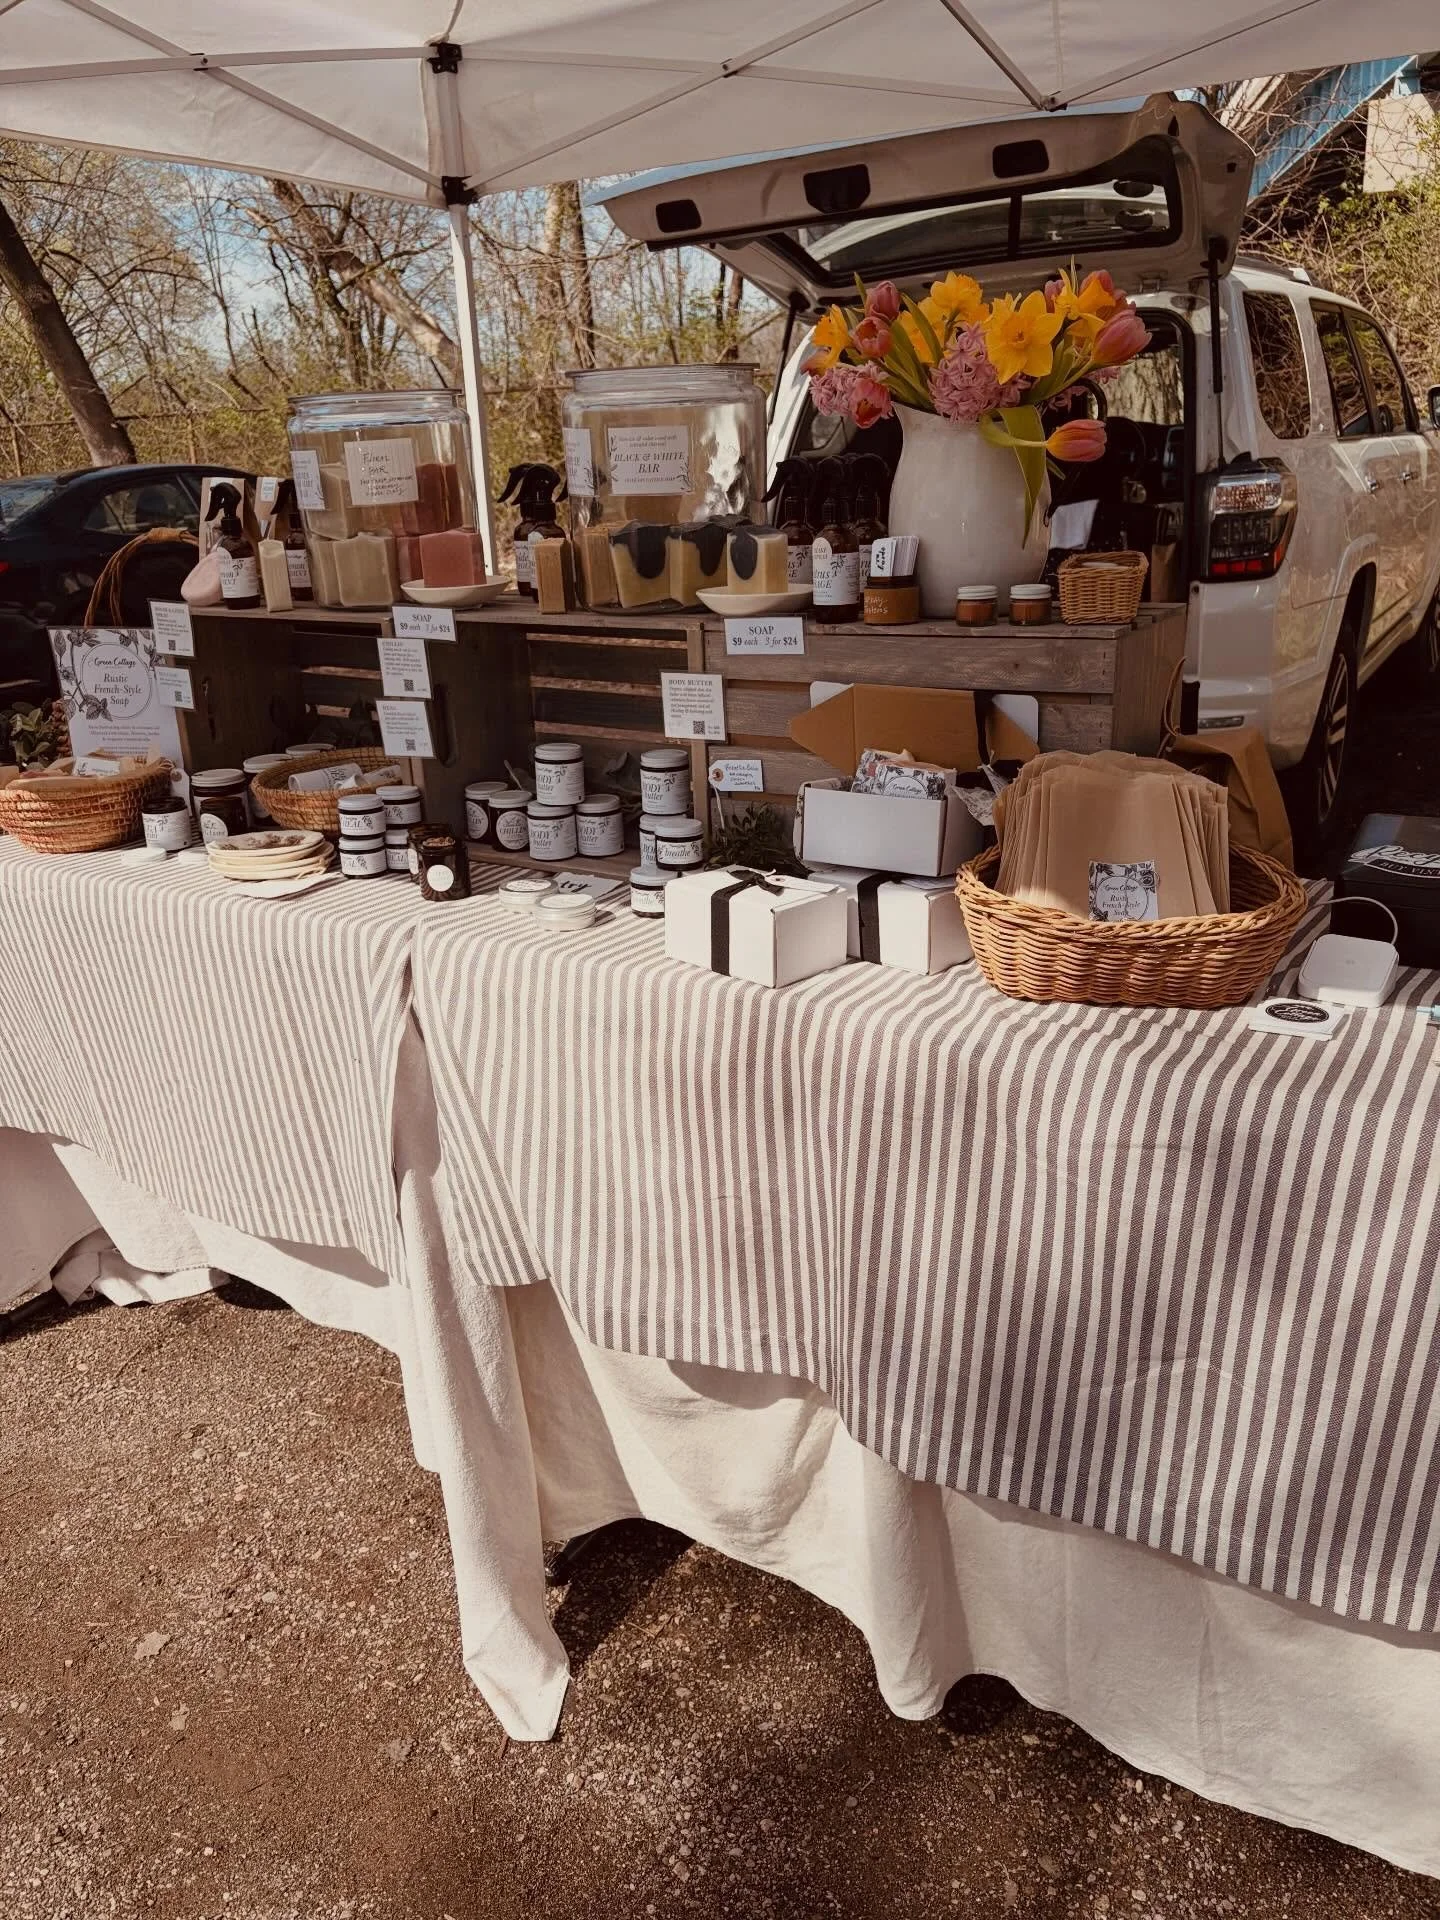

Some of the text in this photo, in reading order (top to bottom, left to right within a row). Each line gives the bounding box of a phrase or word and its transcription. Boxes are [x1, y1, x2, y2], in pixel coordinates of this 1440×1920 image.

[614, 451, 685, 462] BLACK & WHITE
[638, 463, 660, 473] BAR
[411, 614, 432, 623] SOAP
[399, 622, 408, 630] $9
[439, 624, 451, 633] $24
[748, 625, 775, 635] SOAP
[732, 636, 798, 648] $9 each 3 for $24
[94, 657, 136, 668] Green Cottage
[103, 673, 128, 684] Rustic
[688, 679, 713, 687] BUTTER
[94, 685, 142, 697] French-Style
[109, 695, 130, 707] Soap
[664, 845, 691, 857] breathe
[1381, 861, 1405, 871] BUY
[560, 880, 592, 893] try
